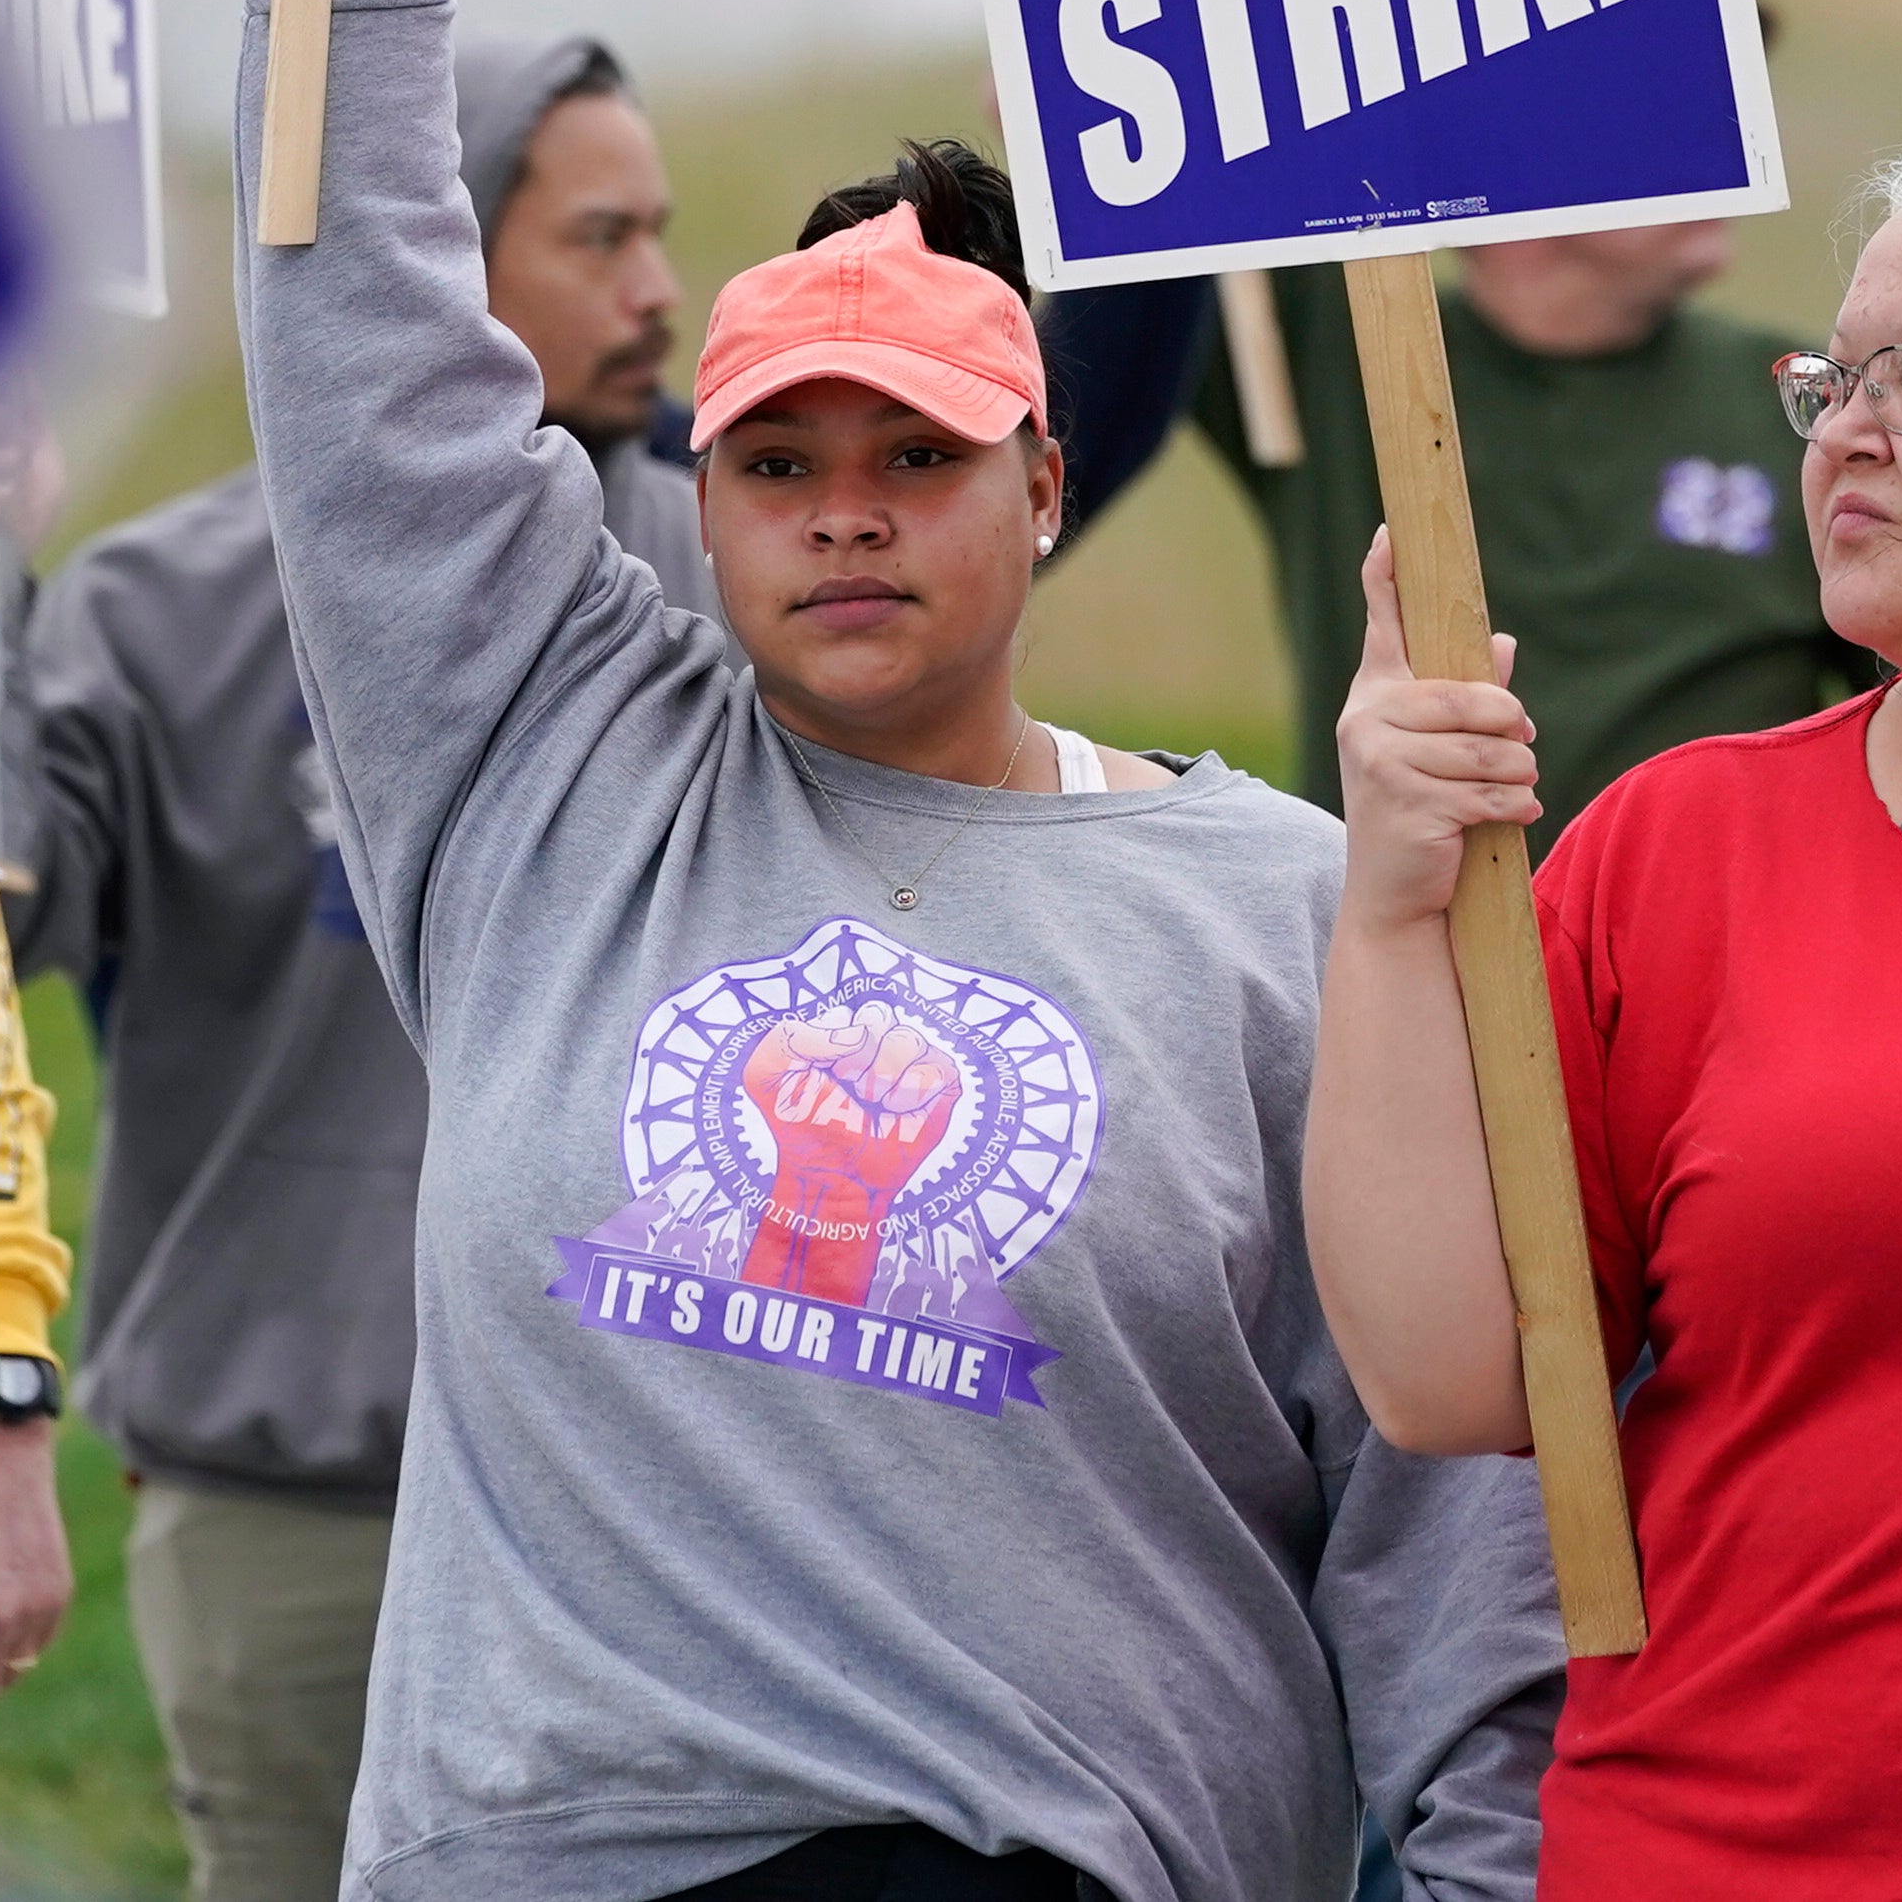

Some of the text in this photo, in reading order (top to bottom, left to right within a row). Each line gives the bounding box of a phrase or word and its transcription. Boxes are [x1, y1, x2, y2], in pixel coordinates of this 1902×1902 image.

[1347, 215, 1363, 224] SON
[783, 1008, 810, 1027] OF
[815, 976, 899, 1020] AMERICA
[903, 988, 970, 1038] UNITED
[716, 1014, 782, 1082] WORKERS
[967, 1033, 1019, 1125] AUTOMOBILE,
[702, 1083, 735, 1172] IMPLEMENT
[774, 1068, 948, 1144] UAW
[926, 1129, 1010, 1219] AEROSPACE
[731, 1176, 869, 1242] AGRICULTURAL
[599, 1264, 987, 1400] IT'S OUR TIME
